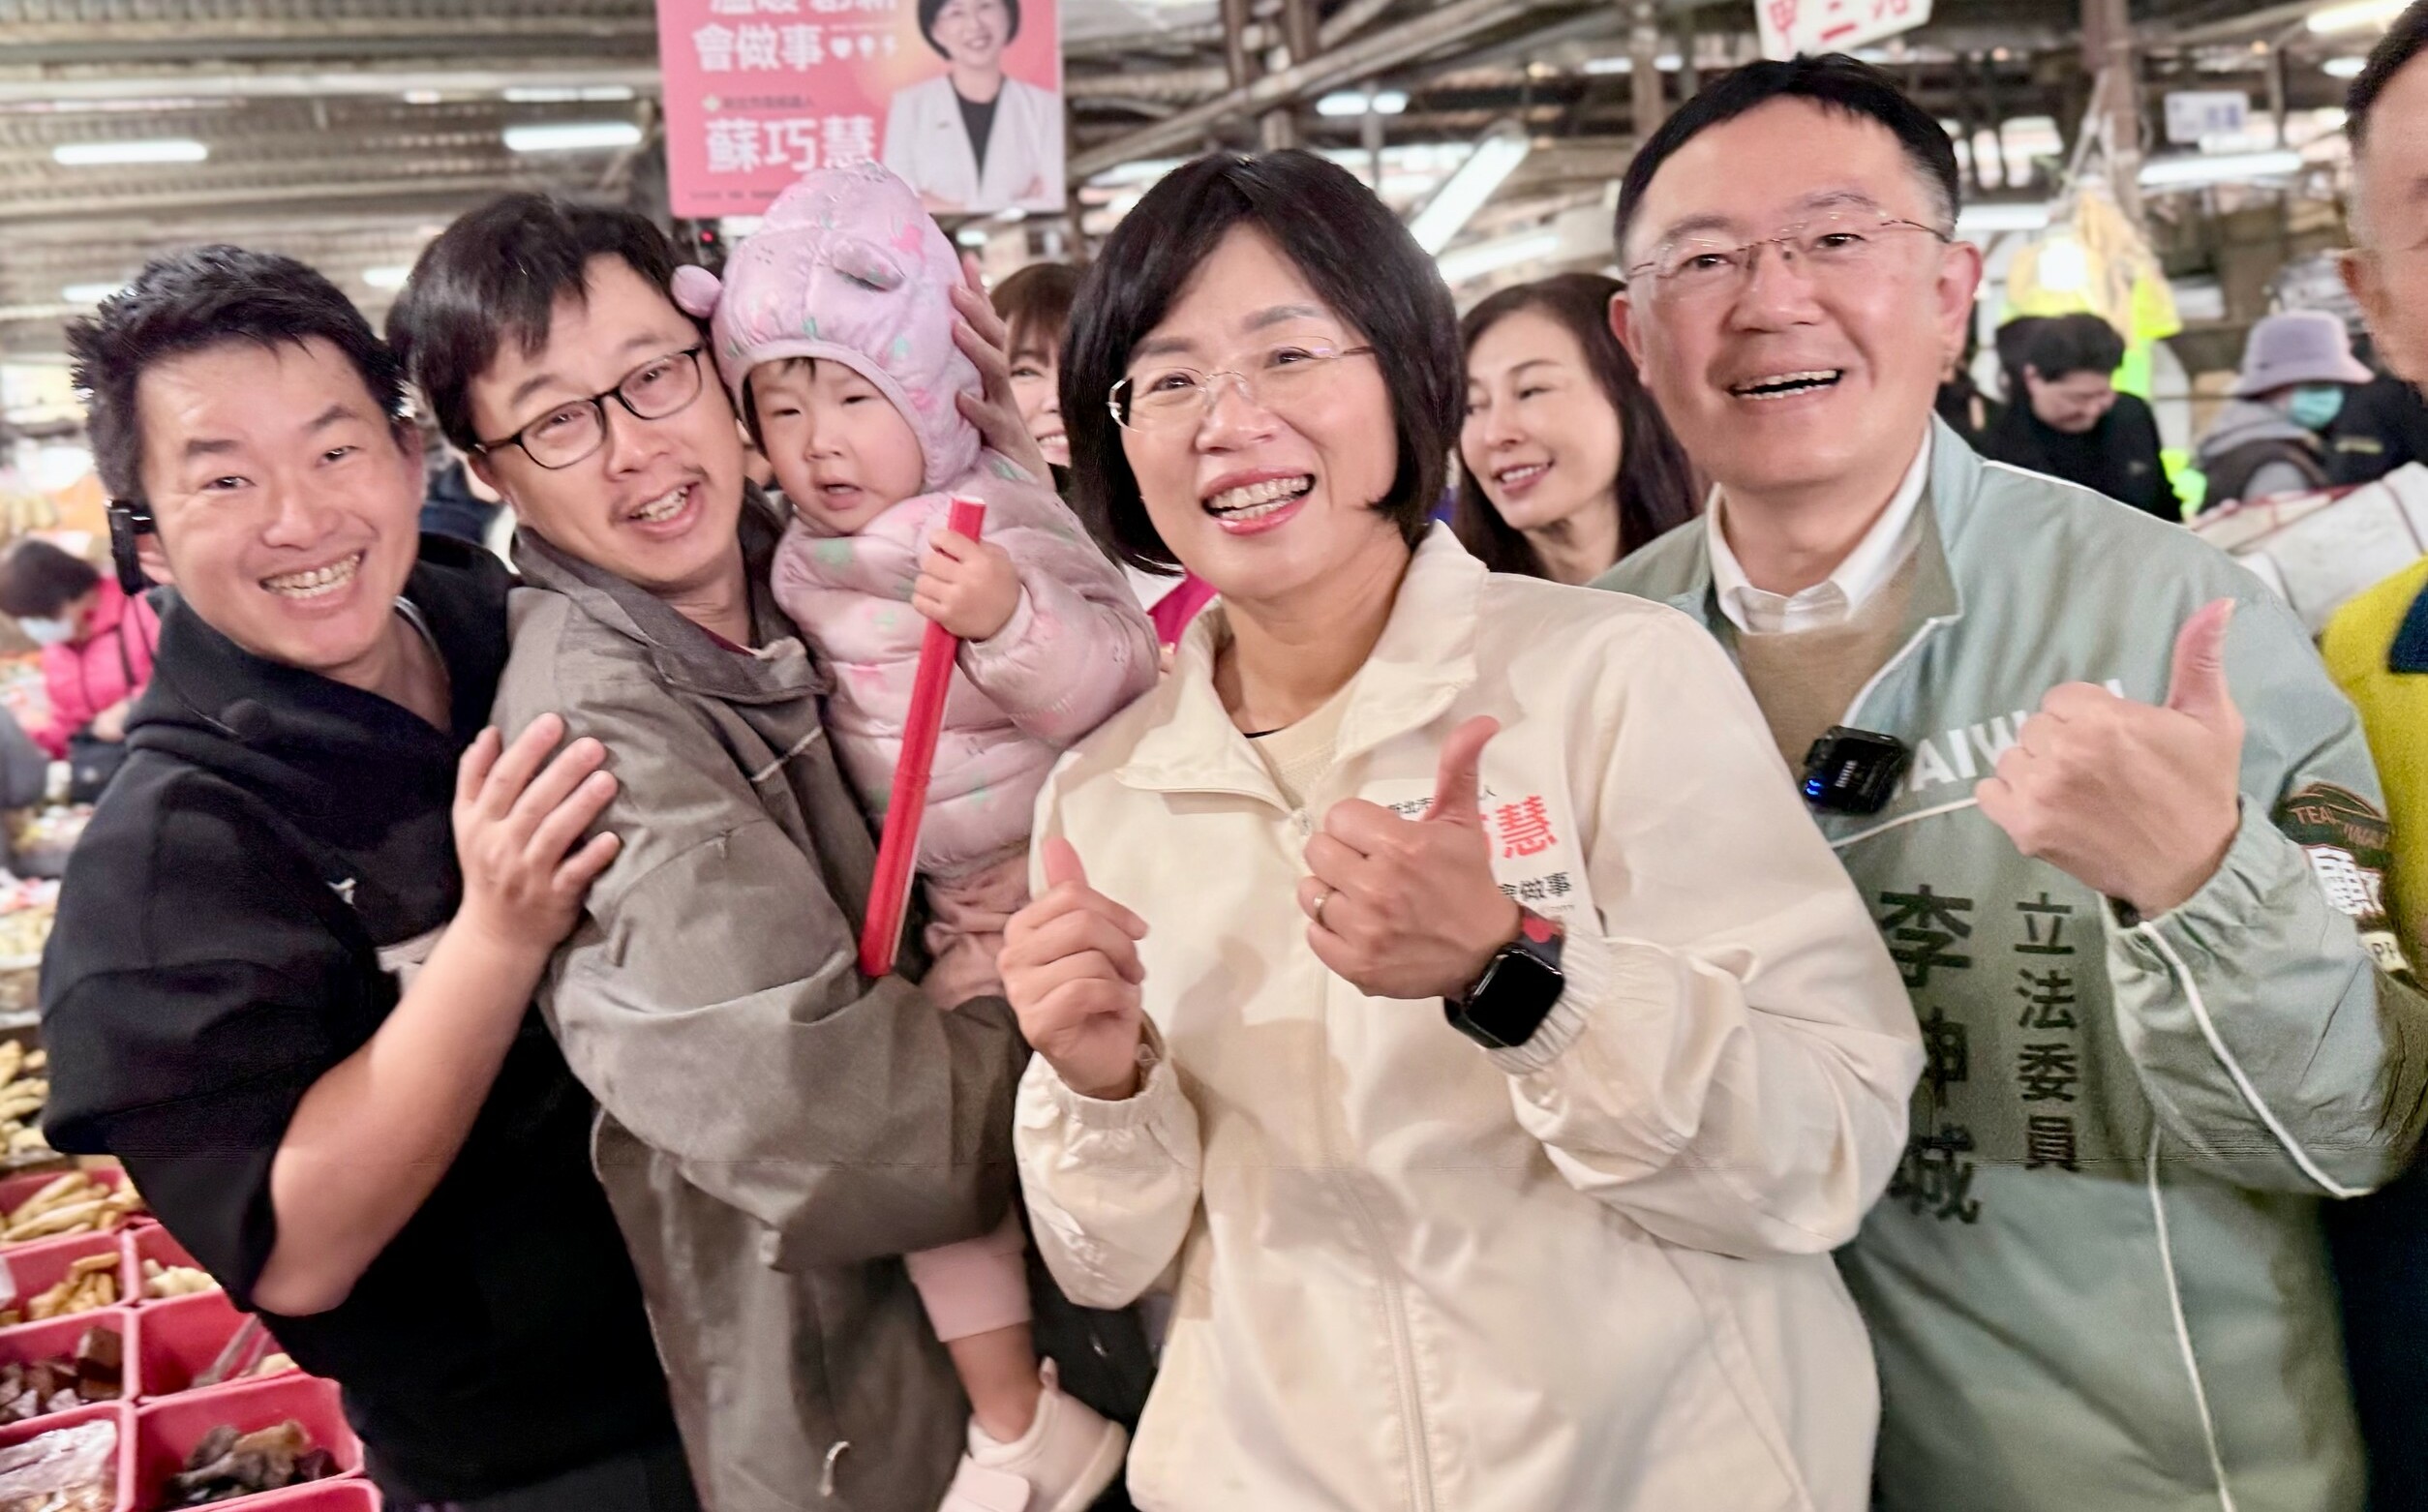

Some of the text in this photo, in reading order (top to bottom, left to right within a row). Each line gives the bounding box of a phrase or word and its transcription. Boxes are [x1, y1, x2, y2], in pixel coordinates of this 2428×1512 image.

[693, 22, 826, 73] 會做事
[2015, 892, 2079, 1171] 立法委員
